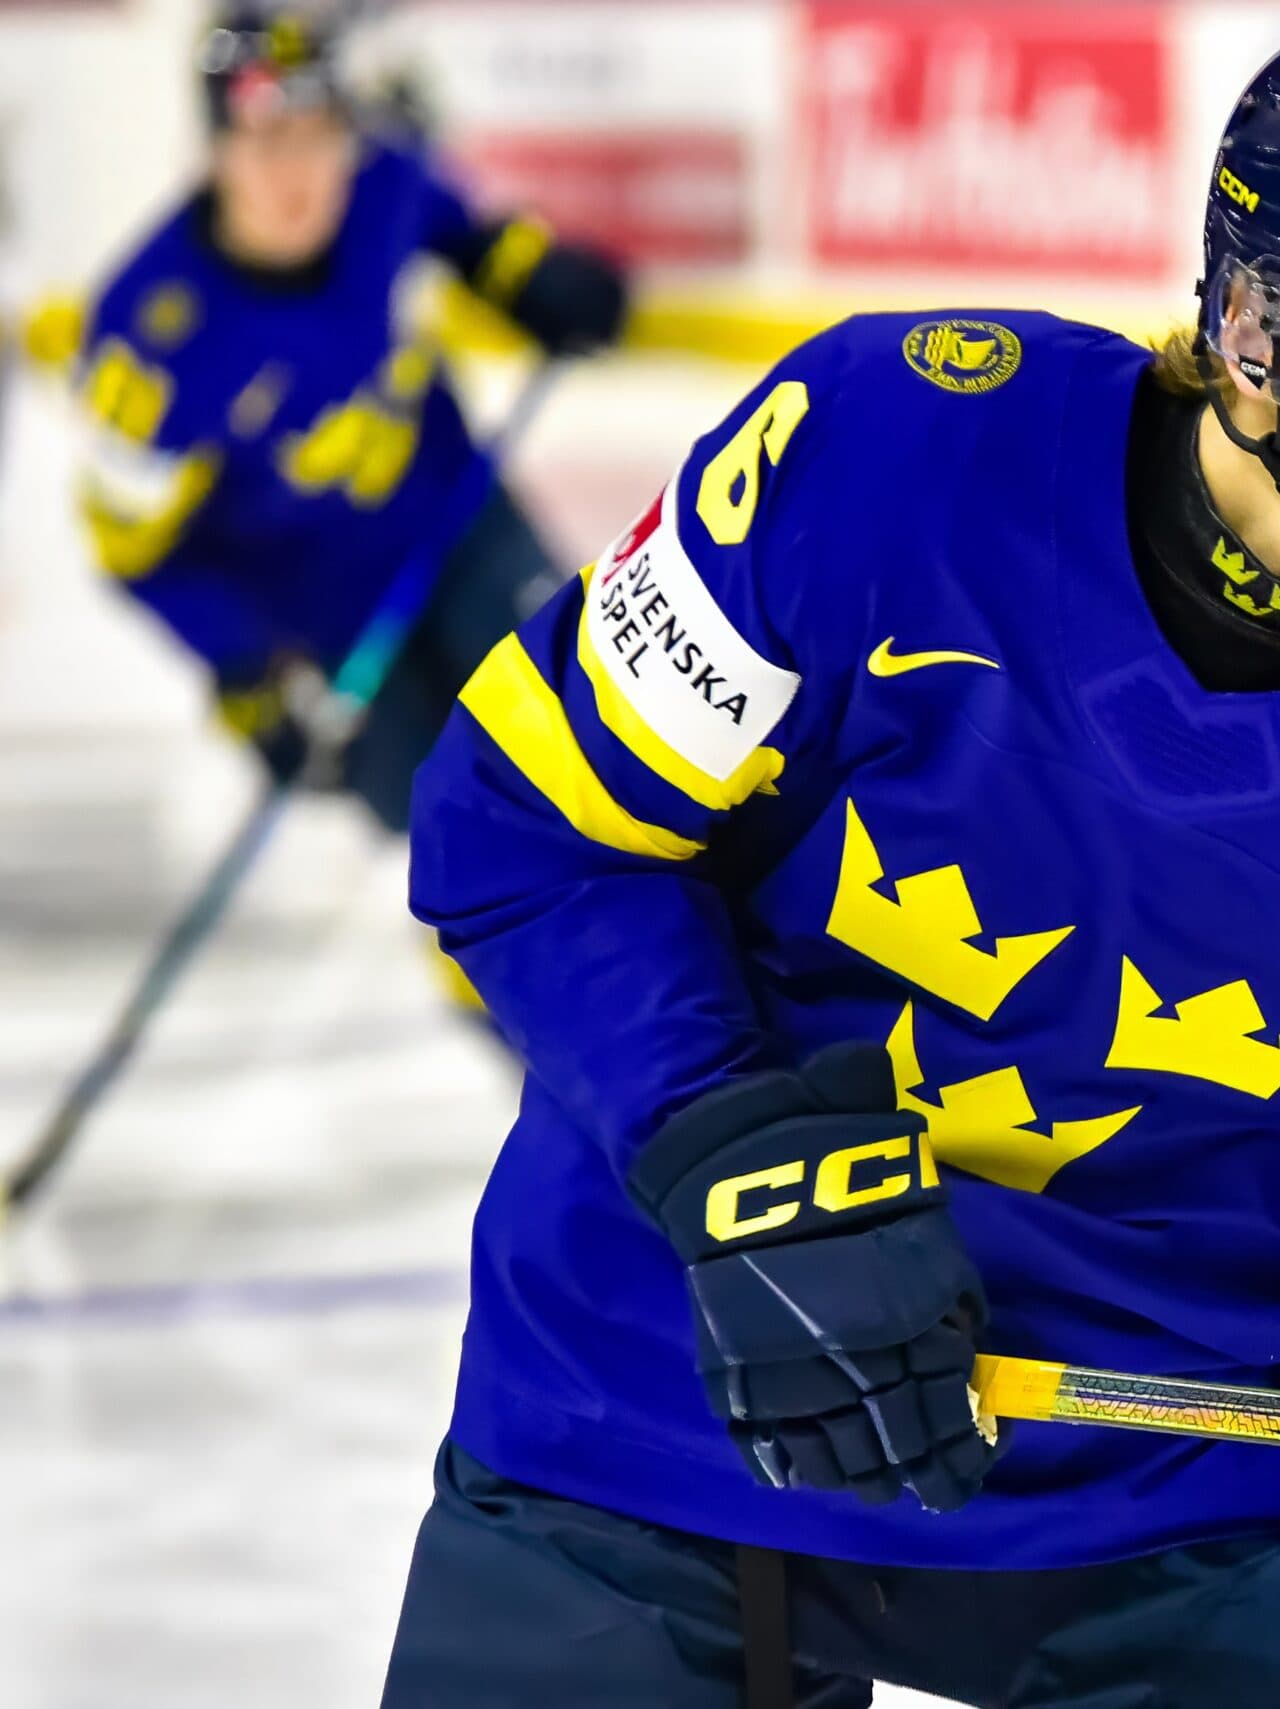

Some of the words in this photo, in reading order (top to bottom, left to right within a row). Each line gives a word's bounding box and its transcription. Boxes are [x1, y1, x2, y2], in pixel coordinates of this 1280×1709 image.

[1219, 166, 1260, 213] CCM
[695, 380, 809, 545] 6
[600, 581, 649, 679] SPEL
[628, 552, 748, 726] SVENSKA
